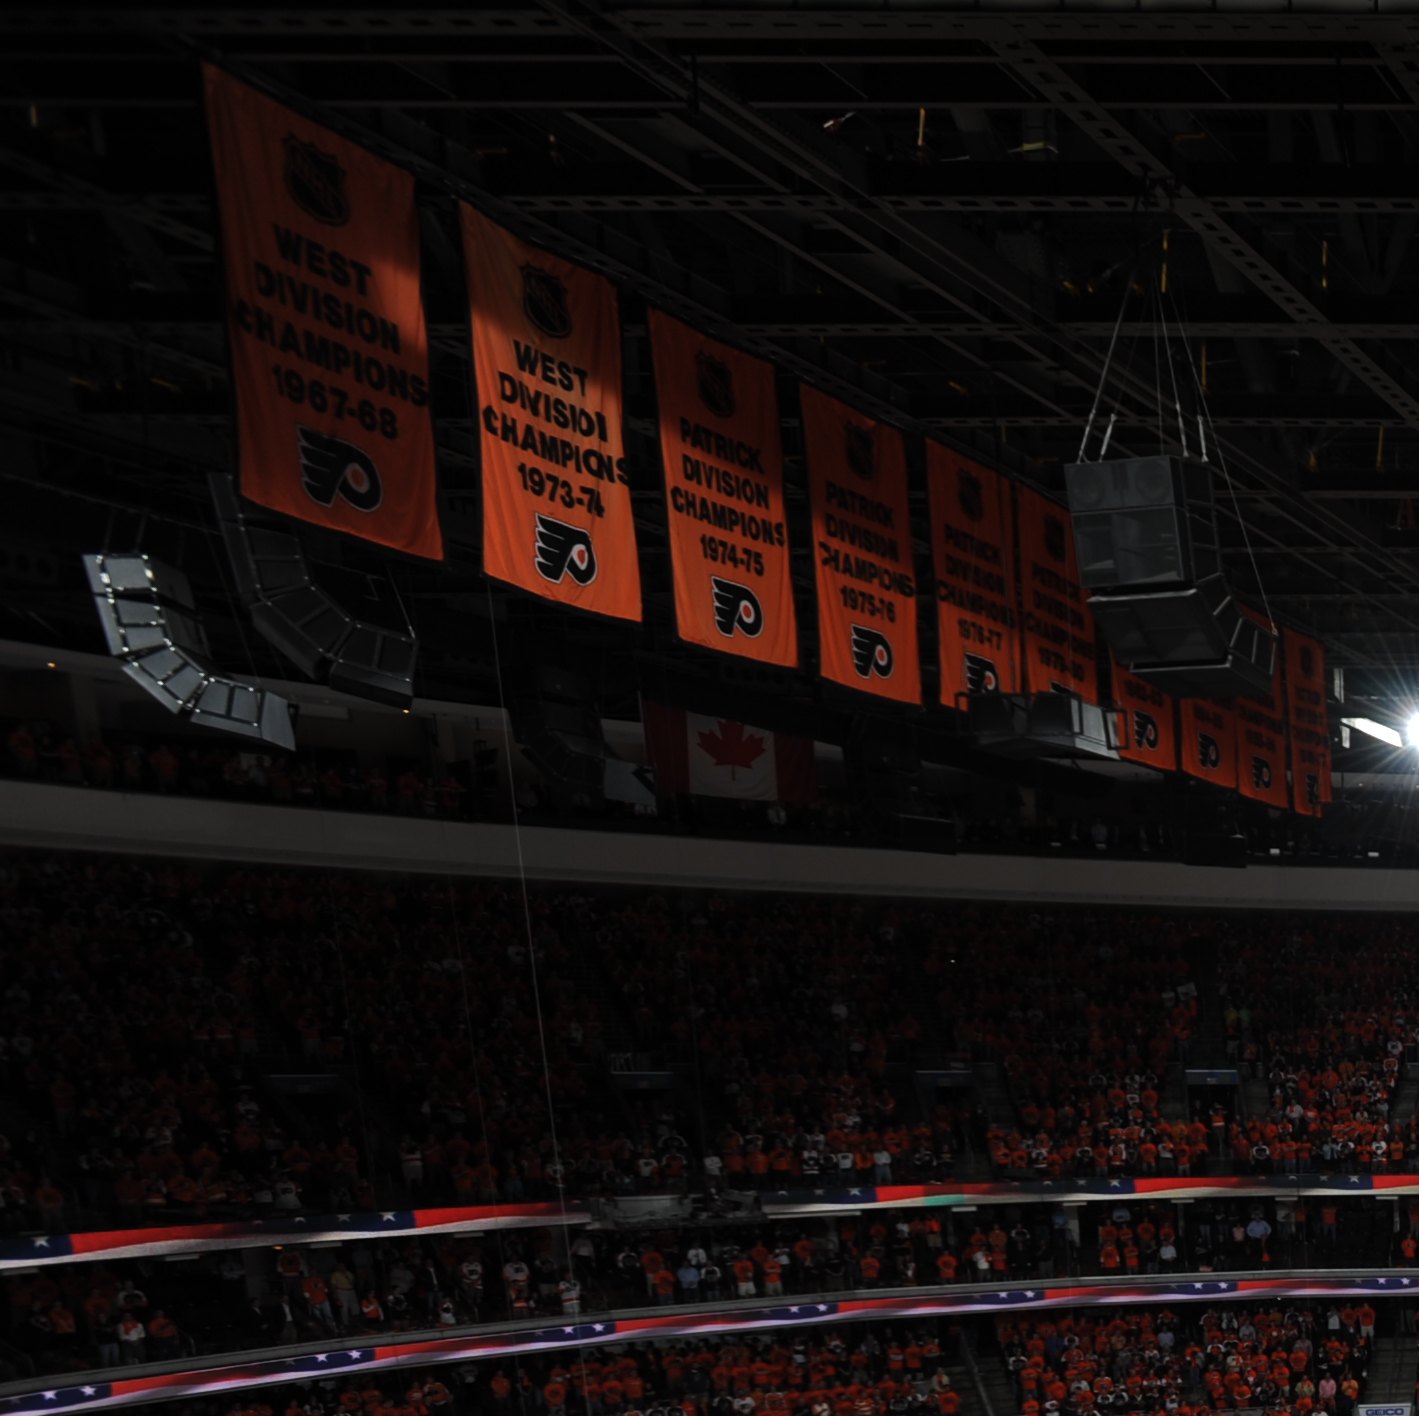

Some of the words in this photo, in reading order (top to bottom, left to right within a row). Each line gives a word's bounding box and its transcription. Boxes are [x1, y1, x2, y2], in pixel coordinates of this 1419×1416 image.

[273, 223, 371, 296] WEST
[254, 260, 400, 354] DIVISION
[237, 299, 429, 407] CHAMPIONS
[514, 339, 588, 397] WEST
[272, 364, 398, 440] 1967-68
[482, 405, 631, 485] CHAMPIONS
[680, 416, 764, 474] PATRICK
[682, 454, 770, 509] DIVISION
[825, 481, 895, 529] PATRICK
[670, 486, 785, 547] CHAMPIONS
[825, 513, 899, 562] DIVISION
[700, 534, 765, 576] 1974-75
[840, 585, 895, 623] 1975-76
[1366, 1408, 1404, 1416] GEICO
